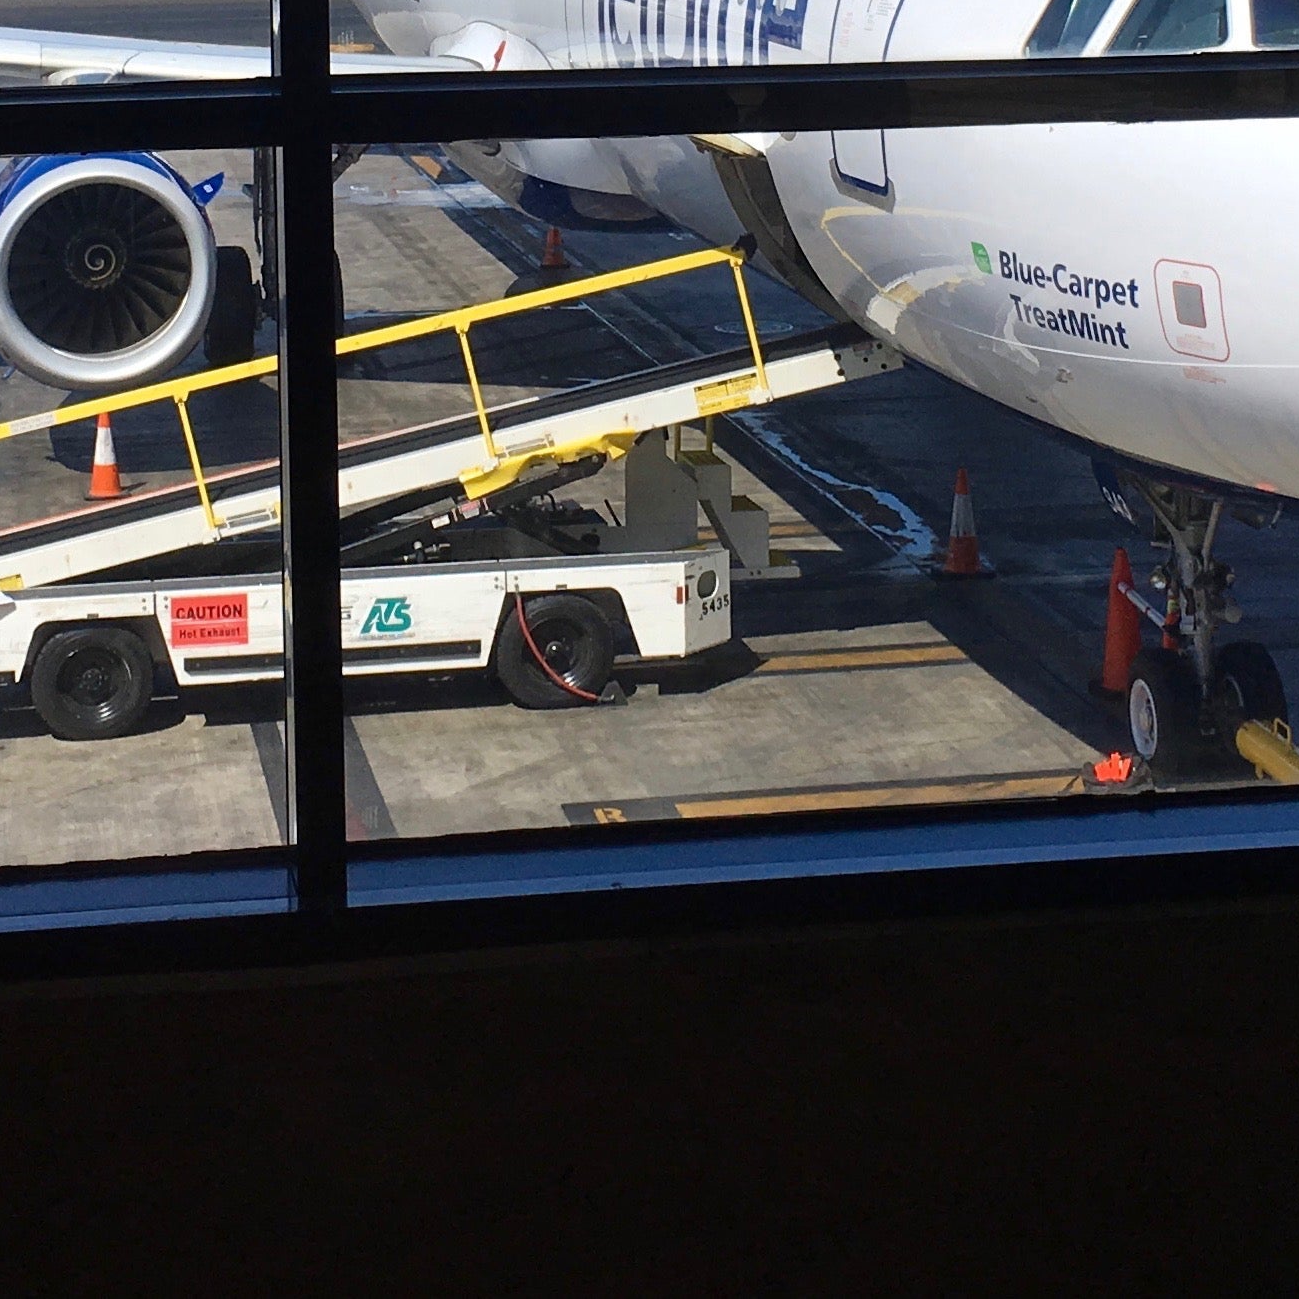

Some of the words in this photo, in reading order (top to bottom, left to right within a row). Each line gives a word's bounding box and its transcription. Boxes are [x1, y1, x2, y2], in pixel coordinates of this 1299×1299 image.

[998, 250, 1140, 309] Blue-Carpet
[1009, 293, 1130, 350] TreatMint
[175, 604, 243, 620] CAUTION
[360, 597, 412, 634] ATS
[702, 594, 730, 615] 5435
[179, 629, 197, 639] Hot
[200, 627, 241, 638] Exhaust
